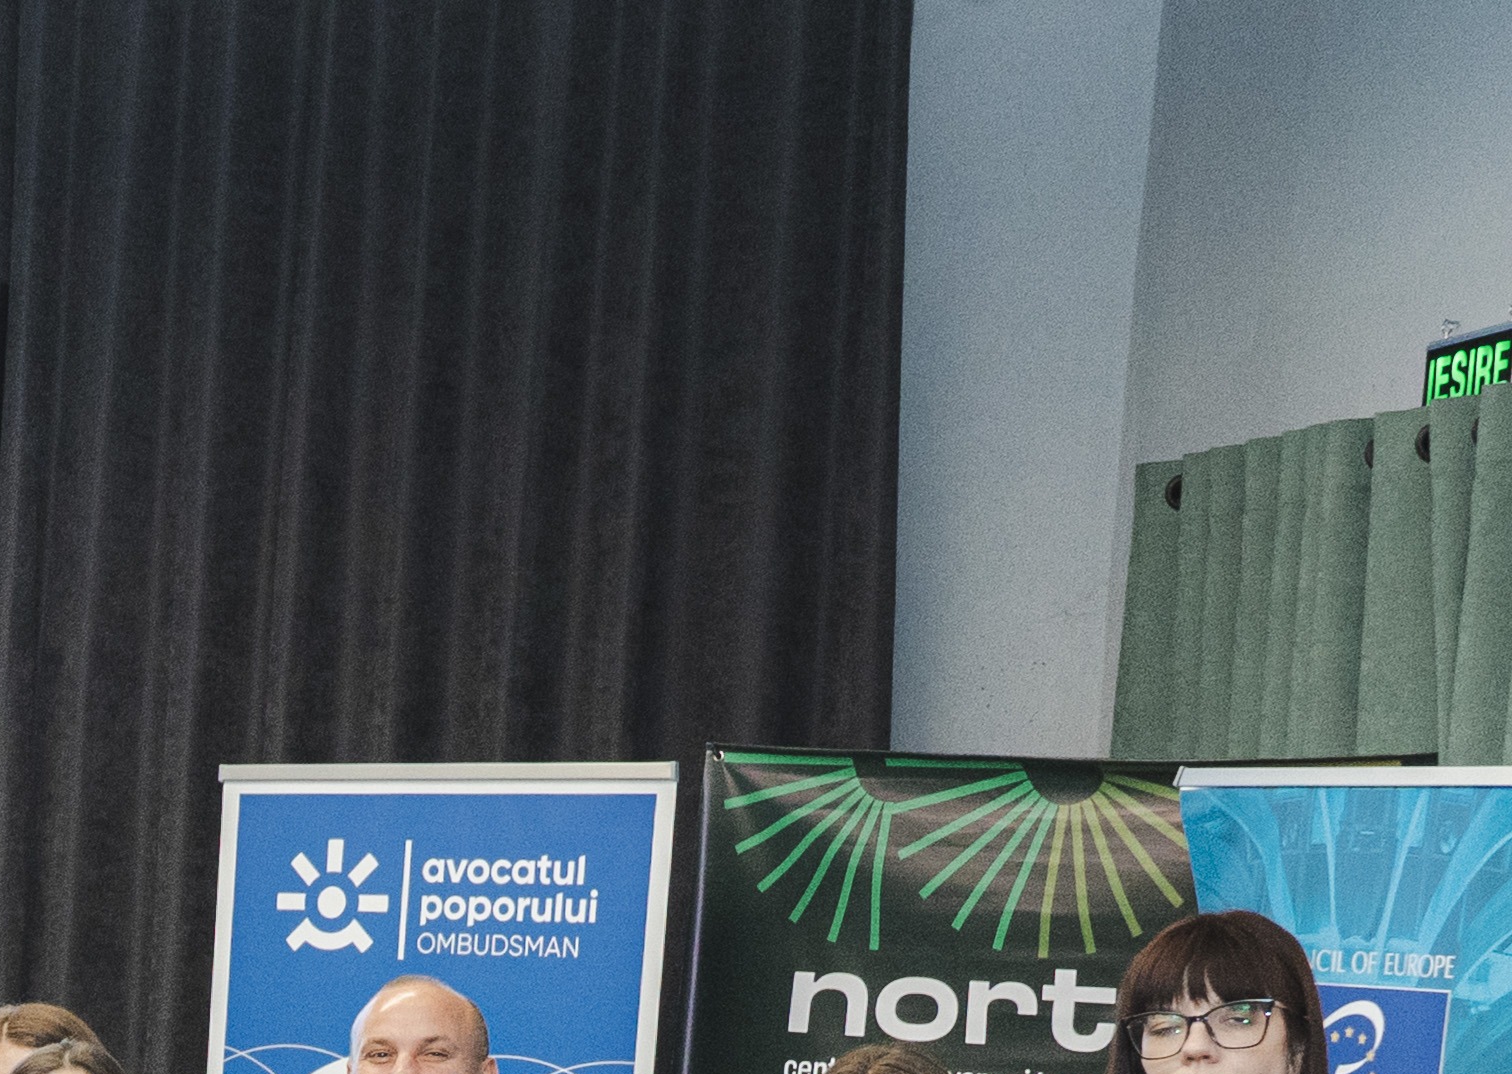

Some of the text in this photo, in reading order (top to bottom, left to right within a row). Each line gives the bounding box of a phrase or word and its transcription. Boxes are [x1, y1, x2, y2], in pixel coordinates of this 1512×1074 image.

[421, 854, 587, 886] avocatul
[418, 889, 599, 928] poporului
[416, 931, 581, 960] OMBUDSMAN
[1351, 950, 1379, 975] OF
[1383, 952, 1457, 980] EUROPE
